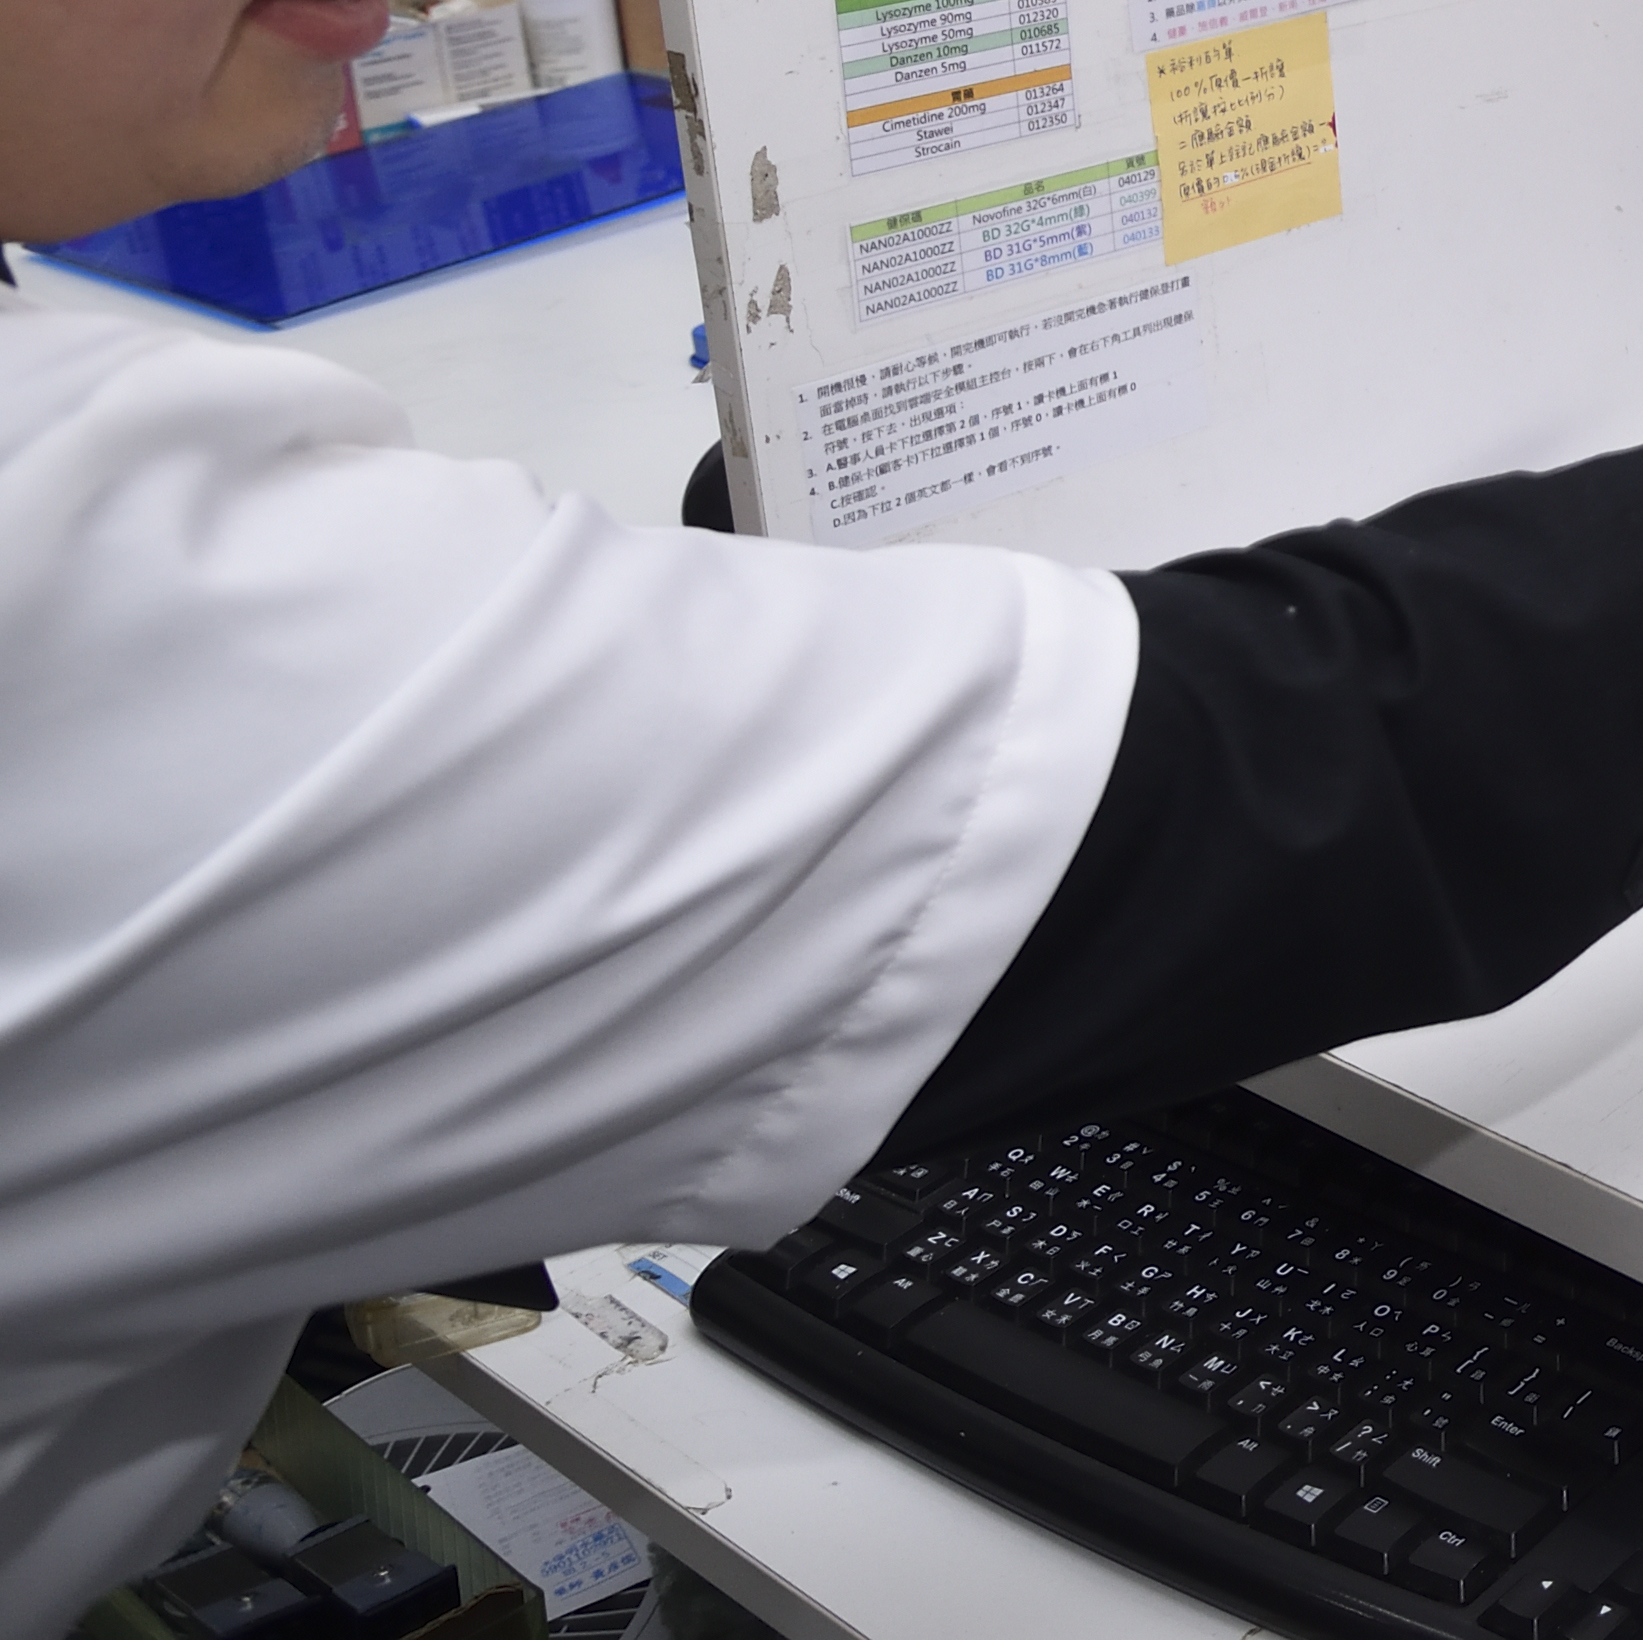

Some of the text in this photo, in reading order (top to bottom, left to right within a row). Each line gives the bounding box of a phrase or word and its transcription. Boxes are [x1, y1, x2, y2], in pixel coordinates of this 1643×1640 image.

[875, 1, 932, 22] Lysozyme
[916, 99, 1065, 141] Stawei 012347
[915, 113, 1067, 158] Strocain 012350
[862, 241, 955, 275] NAN02A1000ZZ
[982, 228, 1000, 242] BD
[1120, 189, 1157, 206] 040399
[1491, 1414, 1525, 1438] Enter
[1411, 1446, 1442, 1469] Shift
[1438, 1528, 1465, 1549] Ctrl
